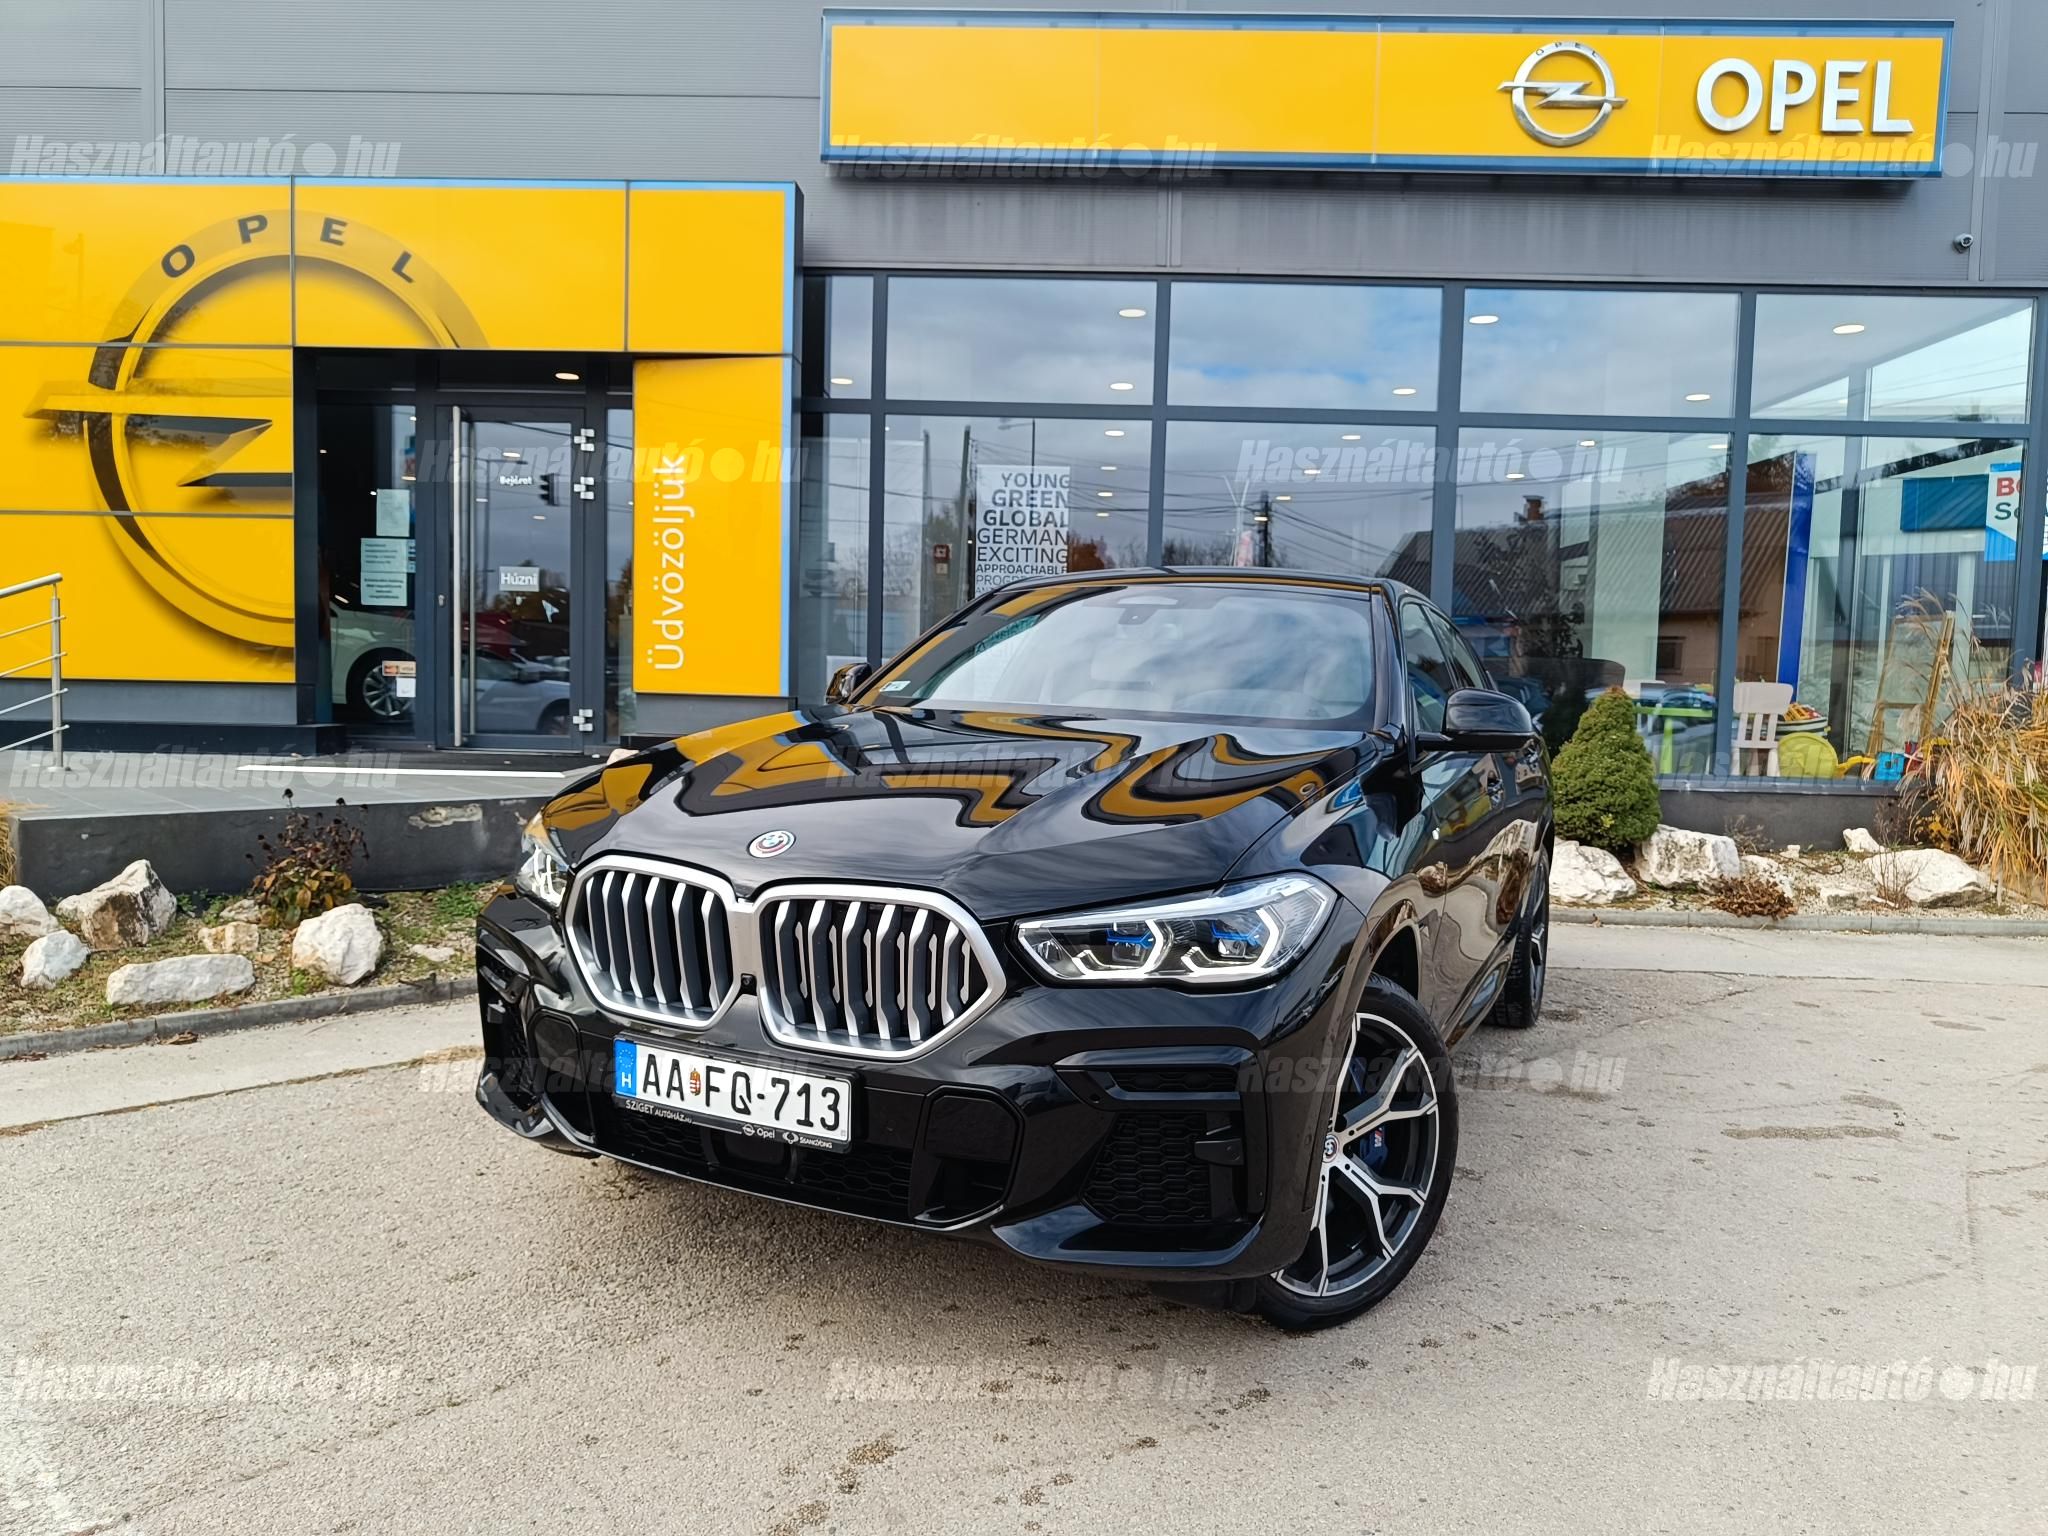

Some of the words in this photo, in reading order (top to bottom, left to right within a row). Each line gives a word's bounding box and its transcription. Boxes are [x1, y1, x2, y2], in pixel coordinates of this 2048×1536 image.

[1696, 57, 1914, 134] OPEL
[161, 213, 416, 284] OPEL
[1002, 472, 1069, 489] YOUNG
[991, 489, 1068, 509] GREEN
[983, 509, 1068, 528] GLOBAL
[977, 528, 1068, 546] GERMAN
[647, 453, 694, 670] Üdvözöljük
[977, 546, 1068, 564] EXCITING
[501, 572, 538, 585] Húzni
[621, 1074, 632, 1089] H
[625, 1099, 654, 1115] SZIGET
[756, 1127, 775, 1139] Opel
